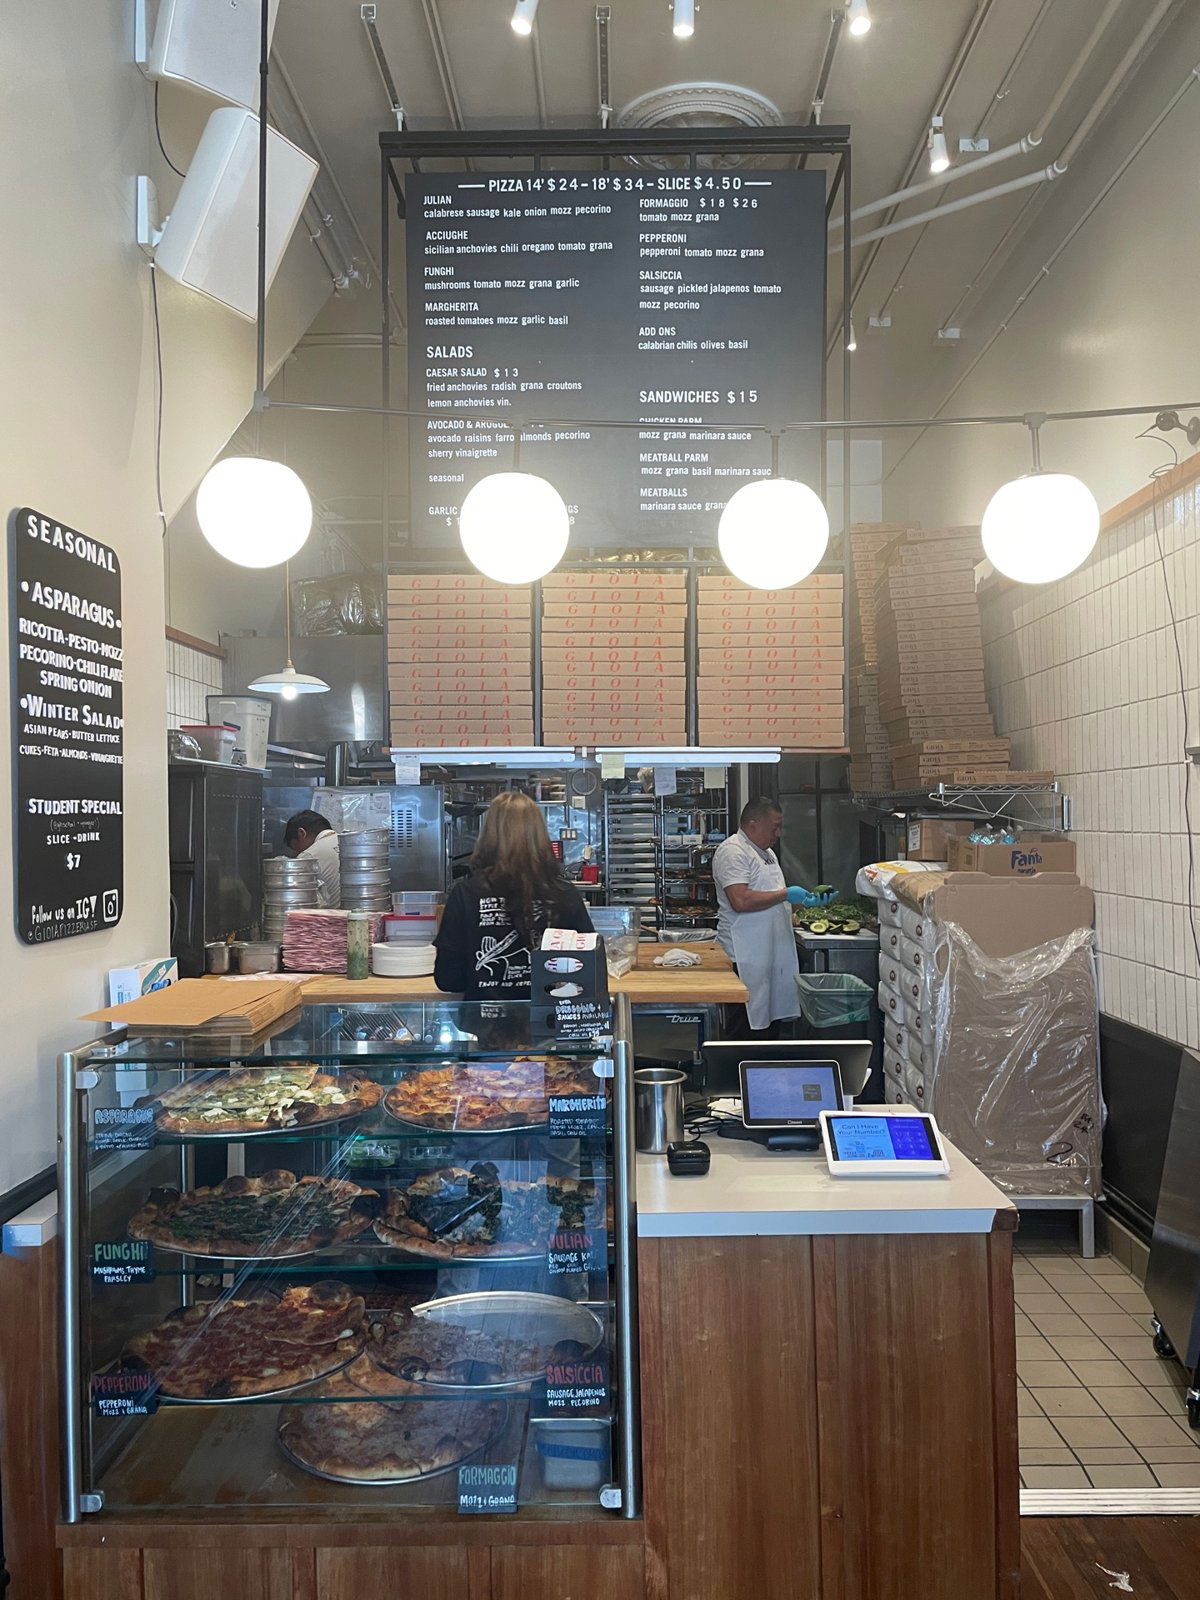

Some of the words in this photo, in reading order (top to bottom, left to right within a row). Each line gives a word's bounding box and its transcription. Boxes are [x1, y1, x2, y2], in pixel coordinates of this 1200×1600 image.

[489, 180, 523, 192] PIZZA
[658, 178, 690, 190] SLICE
[424, 196, 451, 205] JULIAN
[640, 199, 689, 208] FORMAGGIO
[424, 209, 464, 218] calabrese
[467, 209, 500, 218] sausage
[504, 208, 521, 217] kale
[525, 208, 547, 216] onion
[551, 207, 572, 215] mozz
[575, 205, 611, 214] pecorino
[640, 213, 667, 221] tomato
[696, 214, 719, 222] grana
[426, 231, 468, 240] ACCIUGHE
[640, 234, 687, 243] PEPPERONI
[425, 246, 454, 254] sicilian
[456, 244, 497, 253] anchovies
[501, 244, 519, 253] chili
[522, 243, 554, 253] oregano
[558, 242, 586, 250] tomato
[590, 242, 613, 252] grana
[640, 247, 681, 257] pepperoni
[741, 249, 764, 258] grana
[425, 267, 454, 276] FUNGHI
[640, 271, 682, 280] SALSICCIA
[425, 280, 470, 290] mushrooms
[474, 280, 501, 288] tomato
[504, 280, 525, 288] mozz
[529, 279, 552, 289] grana
[556, 278, 580, 288] garlic
[640, 285, 674, 293] sausage
[678, 284, 708, 294] pickled
[710, 284, 750, 294] jalapenos
[754, 285, 782, 293] tomato
[425, 302, 479, 311] MARGHERITA
[640, 301, 660, 309] mozz
[664, 301, 700, 310] pecorino
[425, 316, 455, 325] roasted
[457, 316, 494, 325] tomatoes
[497, 316, 518, 324] mozz
[522, 315, 545, 325] garlic
[549, 316, 568, 325] basil
[639, 327, 656, 336] ADD
[659, 327, 676, 335] ONS
[638, 341, 675, 350] calabrian
[677, 341, 697, 350] chilis
[701, 341, 725, 349] olives
[729, 340, 748, 349] basil
[427, 346, 473, 359] SALADS
[426, 369, 458, 377] CAESAR
[461, 368, 487, 377] SALAD
[427, 383, 445, 391] fried
[447, 382, 488, 391] anchovies
[491, 382, 516, 391] radish
[521, 382, 544, 391] grana
[547, 381, 582, 390] croutons
[640, 391, 719, 403] SANDWICHES
[428, 399, 451, 407] lemon
[454, 398, 495, 407] anchovies
[497, 398, 512, 406] vin.
[427, 421, 465, 430] AVOCADO
[428, 434, 461, 443] avocado
[465, 434, 492, 442] raisins
[495, 433, 514, 442] farro
[555, 431, 591, 440] pecorino
[663, 431, 686, 440] grana
[690, 431, 725, 439] marinara
[728, 432, 751, 440] sauce
[428, 449, 453, 458] sherry
[456, 447, 497, 458] vinaigrette
[640, 454, 682, 462] MEATBALL
[684, 453, 708, 462] PARM
[666, 468, 689, 476] grana
[692, 467, 712, 475] basil
[715, 466, 750, 475] marinara
[429, 474, 464, 482] seasonal
[640, 488, 687, 497] MEATBALLS
[429, 507, 457, 515] GARLIC
[640, 502, 676, 510] marinara
[28, 515, 116, 573] SEASONAL
[32, 581, 115, 629] ASPARAGUS
[40, 670, 78, 692] SPRING
[79, 679, 112, 698] ONION
[23, 723, 47, 736] ASIAN
[28, 798, 80, 815] STUDENT
[81, 799, 122, 815] SPECIAL
[46, 834, 70, 845] SLICE
[66, 852, 81, 870] $7
[1011, 850, 1043, 870] Fanta
[31, 904, 52, 925] Follow
[55, 907, 65, 920] us
[67, 907, 75, 919] on
